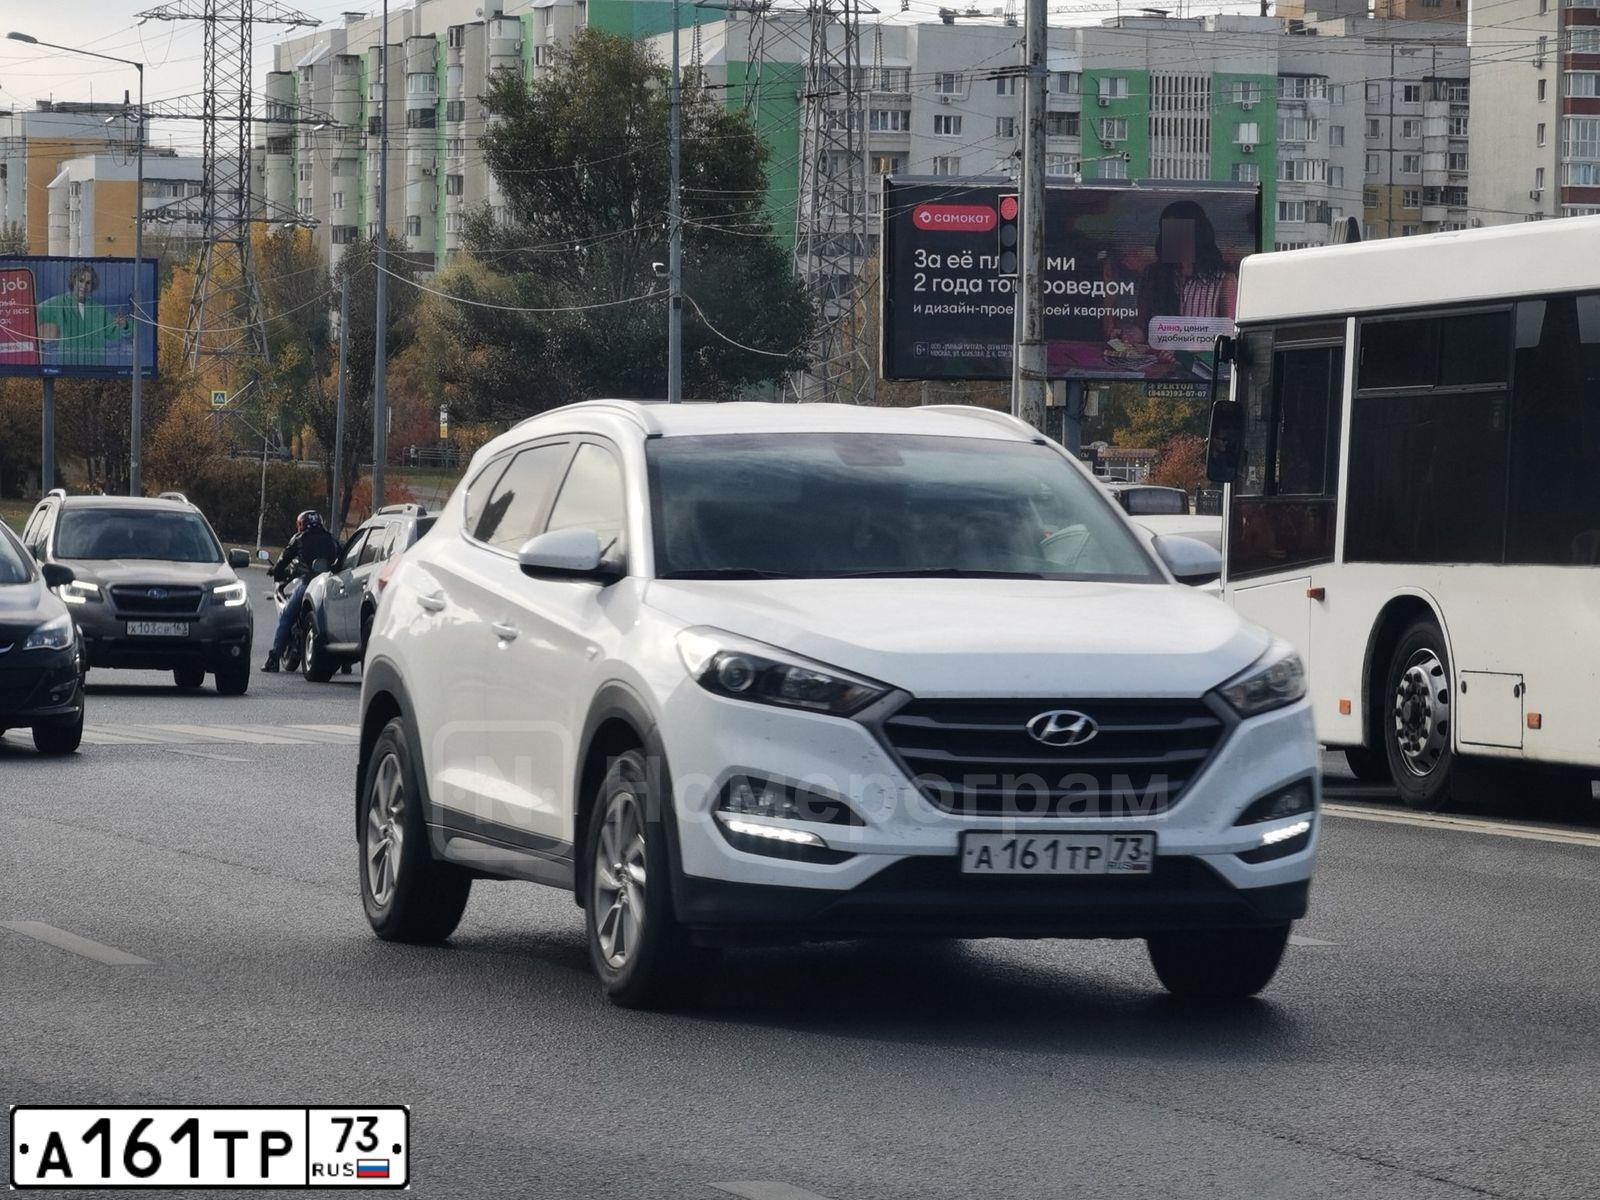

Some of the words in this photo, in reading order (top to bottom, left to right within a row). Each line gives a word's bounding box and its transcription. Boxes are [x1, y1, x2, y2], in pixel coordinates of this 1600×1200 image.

[934, 213, 991, 224] самокат
[914, 249, 941, 268] За
[947, 250, 973, 268] её
[914, 272, 926, 292] 2
[932, 278, 983, 295] года
[913, 304, 921, 313] и
[924, 302, 1014, 317] дизайн-прое
[1074, 307, 1139, 319] квартиры
[1184, 325, 1209, 333] ценит
[1157, 334, 1196, 344] удобный
[974, 839, 1102, 869] А161ТР
[1113, 838, 1145, 861] 73
